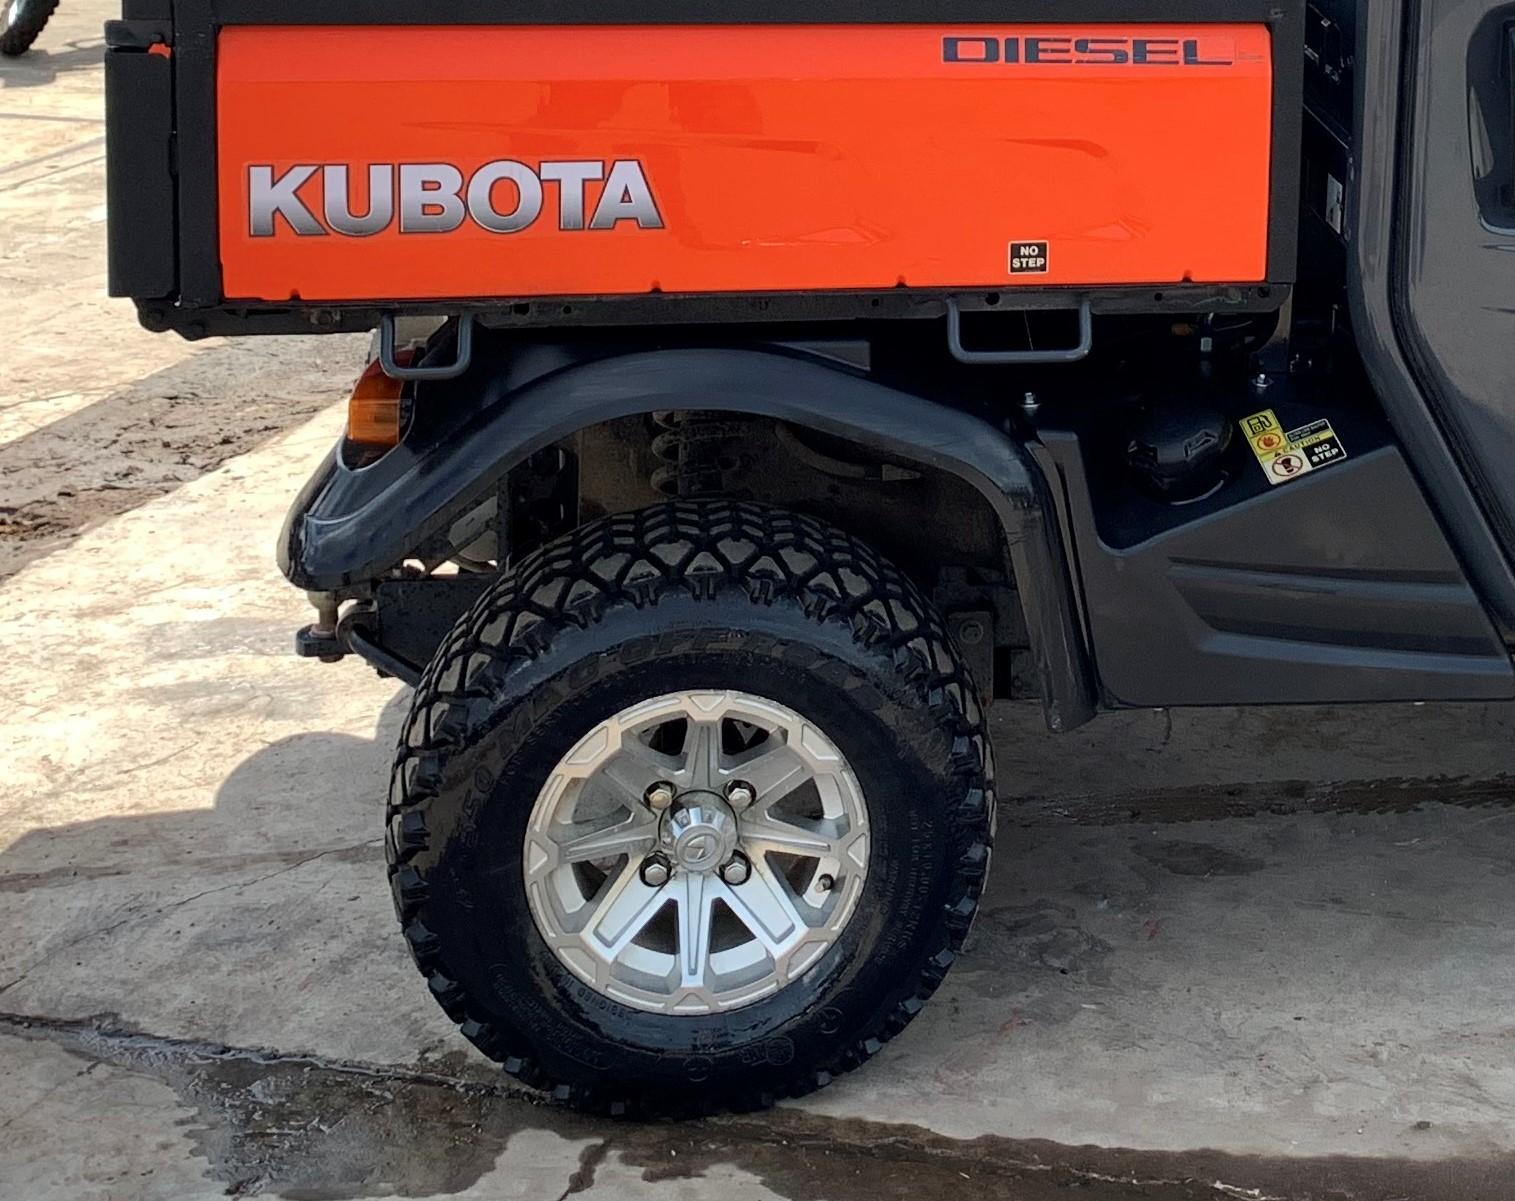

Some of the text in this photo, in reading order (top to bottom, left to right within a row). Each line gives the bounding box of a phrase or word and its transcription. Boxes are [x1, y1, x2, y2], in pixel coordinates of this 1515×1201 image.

[943, 37, 1233, 65] DIESEL
[248, 159, 665, 237] KUBOTA
[1020, 245, 1039, 256] NO
[1012, 257, 1045, 268] STEP
[1284, 435, 1321, 453] CAUTION
[1313, 443, 1330, 454] NO
[1311, 447, 1339, 462] STEP
